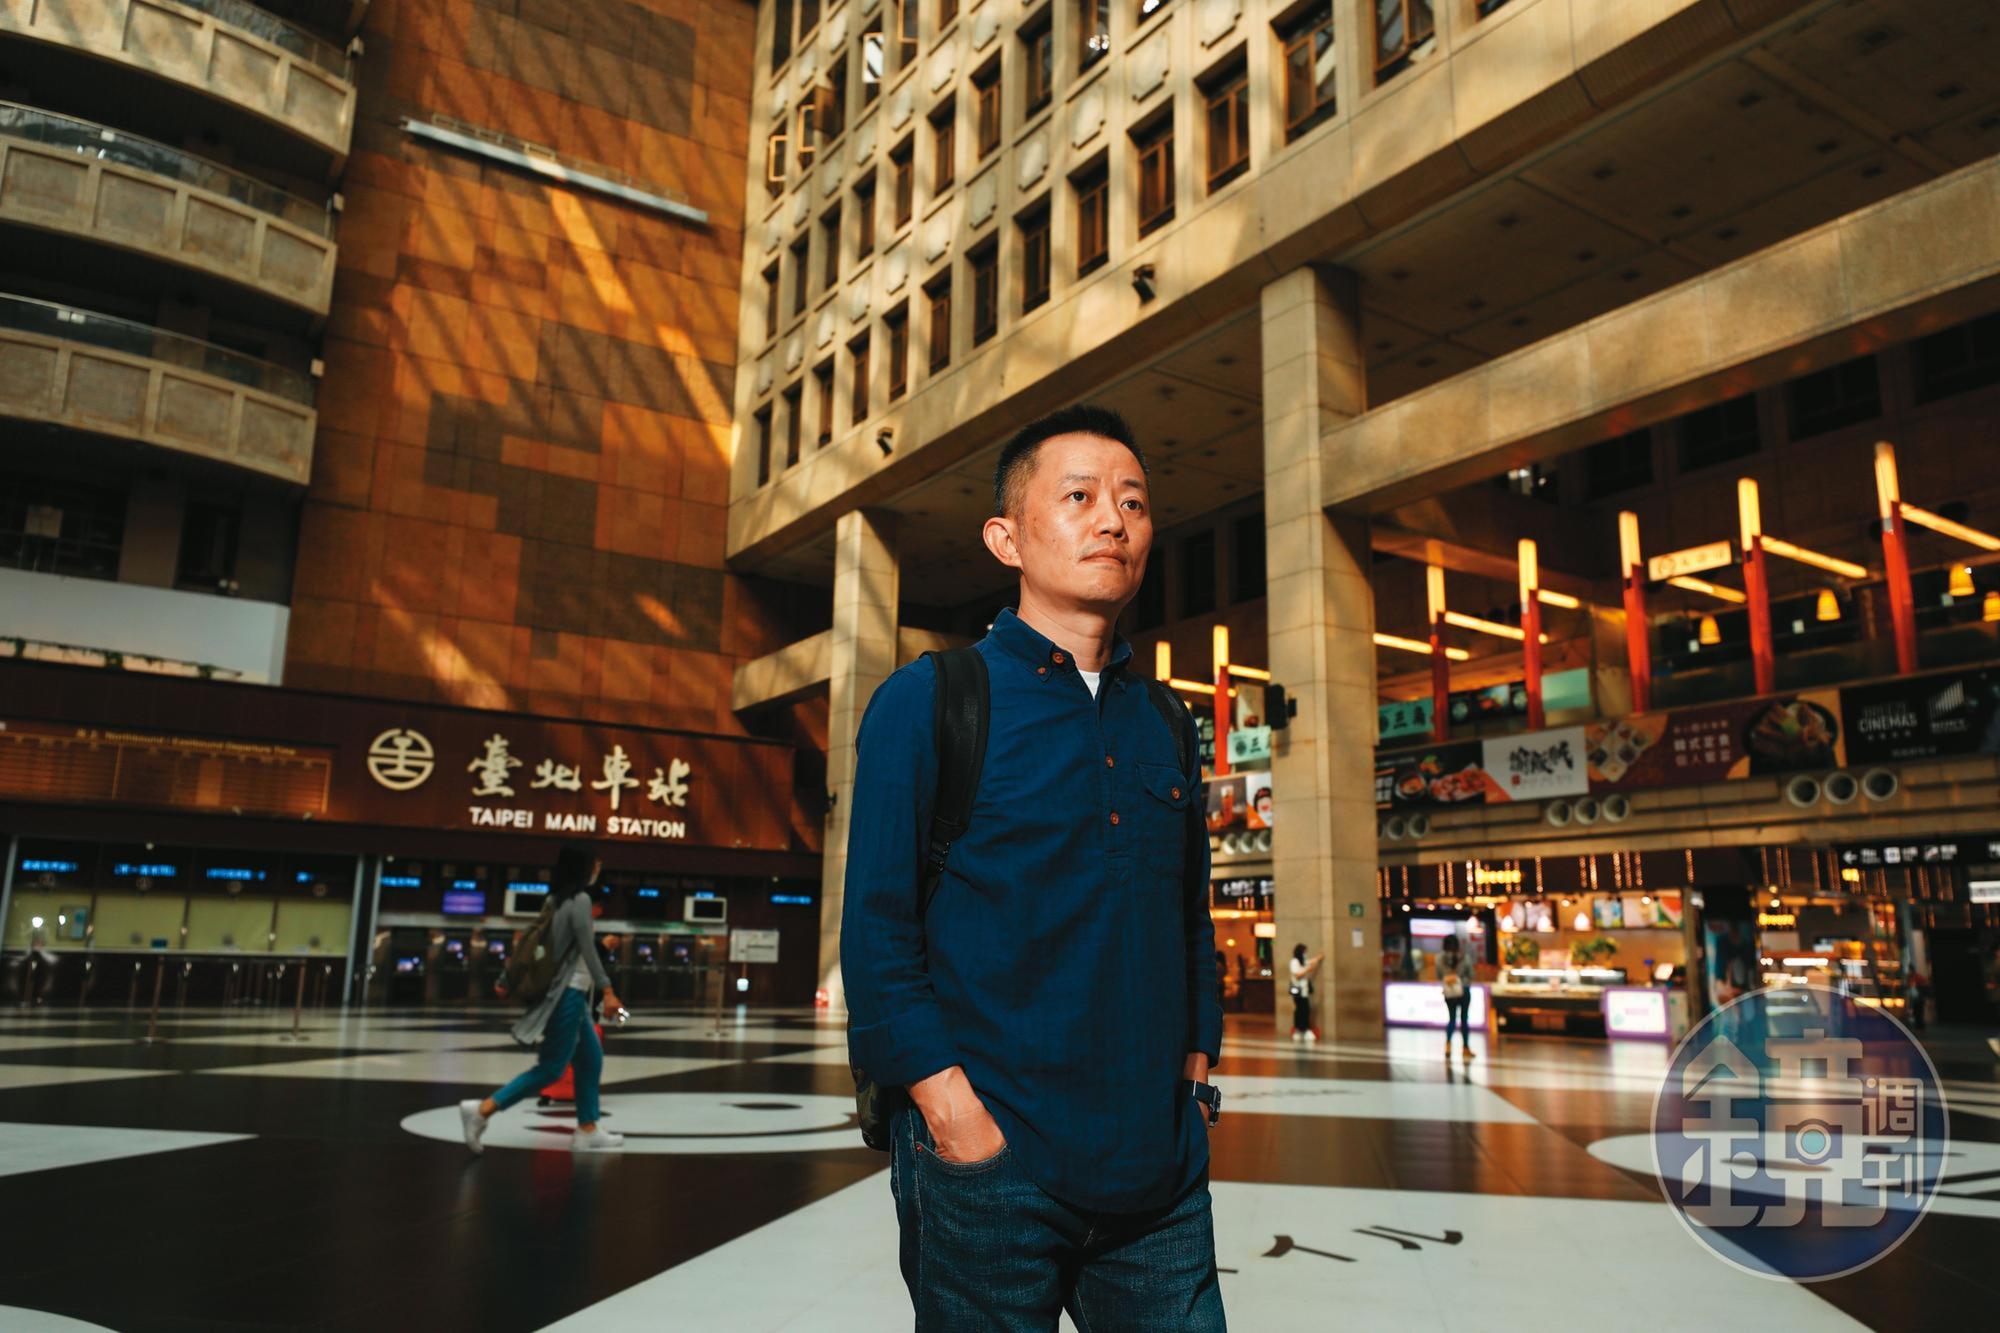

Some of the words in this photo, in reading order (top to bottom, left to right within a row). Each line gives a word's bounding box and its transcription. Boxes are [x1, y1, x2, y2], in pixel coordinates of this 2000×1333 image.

[467, 733, 692, 810] 臺北車站
[469, 806, 534, 829] TAIPEI
[545, 812, 596, 833] MAIN
[606, 816, 686, 839] STATION
